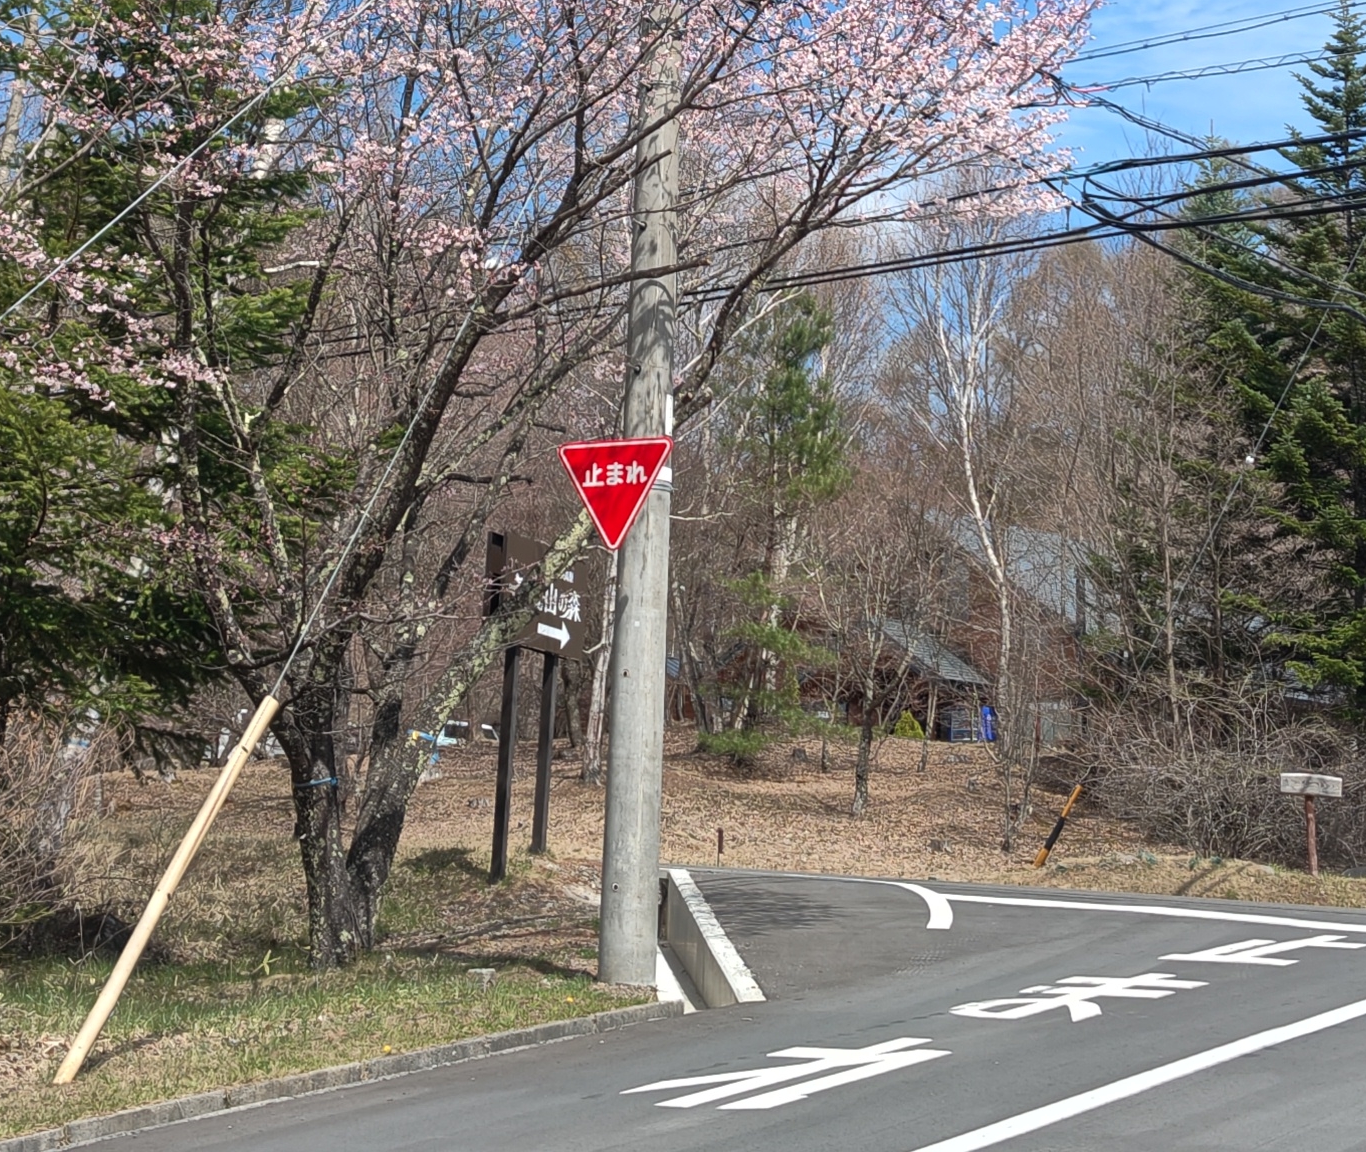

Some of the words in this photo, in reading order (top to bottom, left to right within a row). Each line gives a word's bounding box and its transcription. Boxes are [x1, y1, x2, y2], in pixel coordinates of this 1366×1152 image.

[581, 460, 648, 488] 止まれ
[535, 583, 582, 623] 山の森
